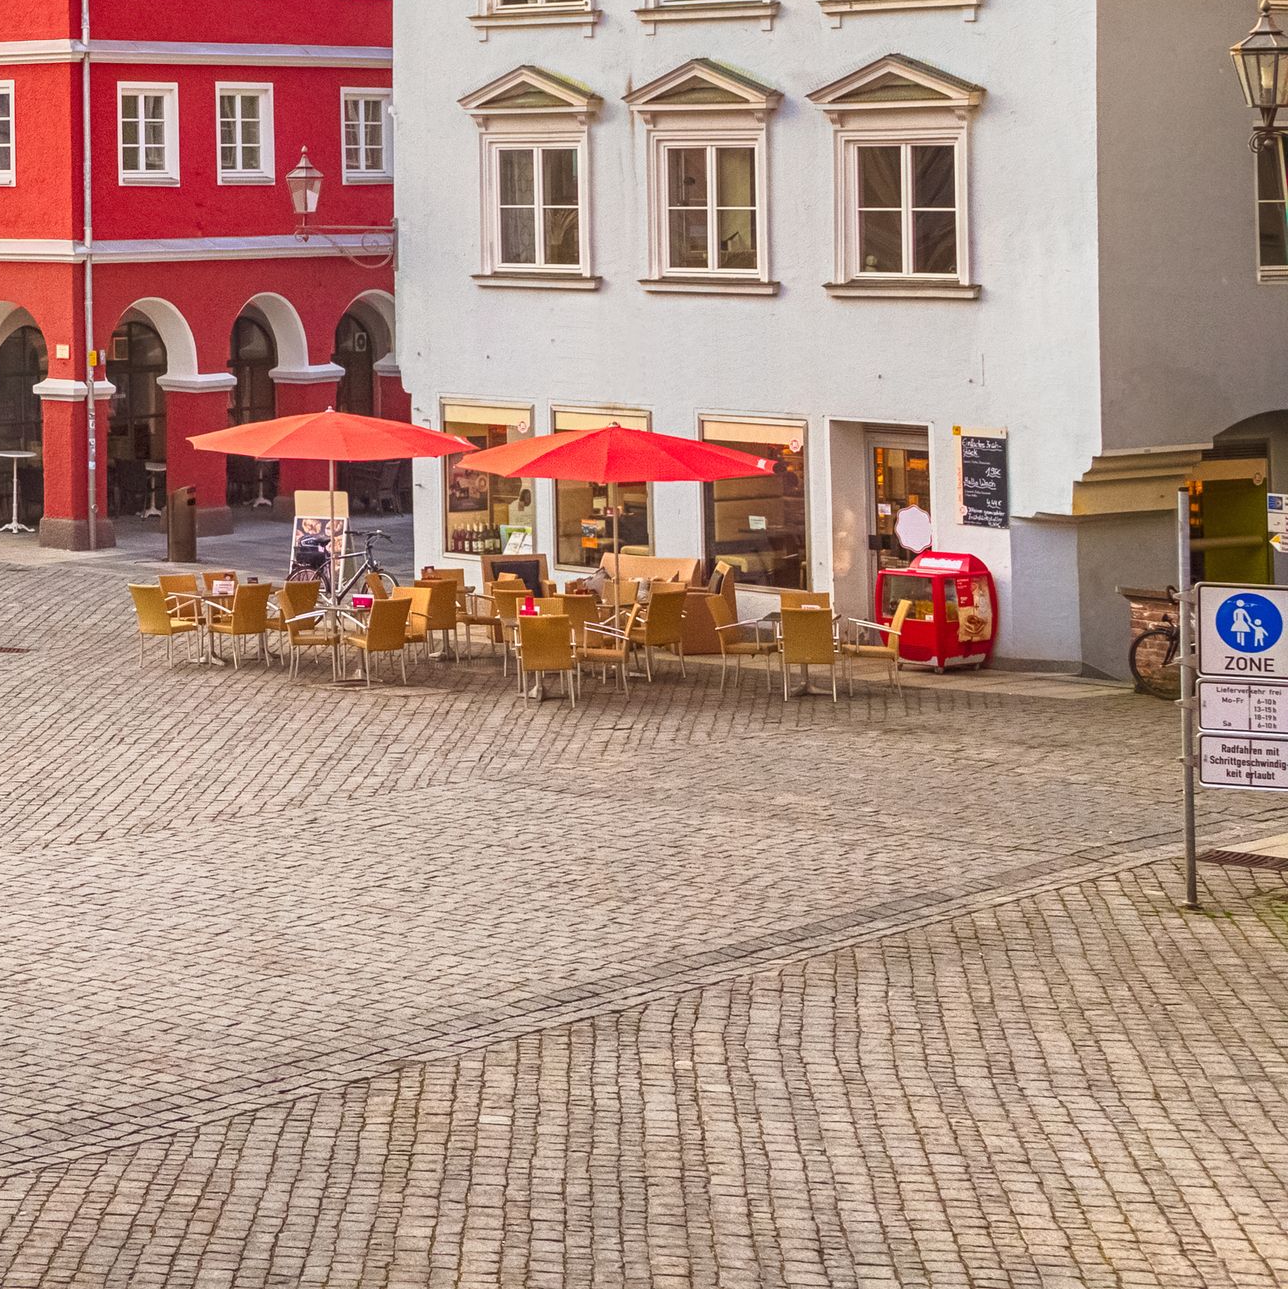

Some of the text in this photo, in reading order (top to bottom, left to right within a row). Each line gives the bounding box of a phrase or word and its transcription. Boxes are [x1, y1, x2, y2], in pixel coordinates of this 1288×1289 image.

[1225, 656, 1275, 673] ZONE
[1216, 687, 1266, 695] Lieferverkehr
[1221, 744, 1280, 756] Radfahren mit
[1226, 769, 1276, 780] keit erlaubt
